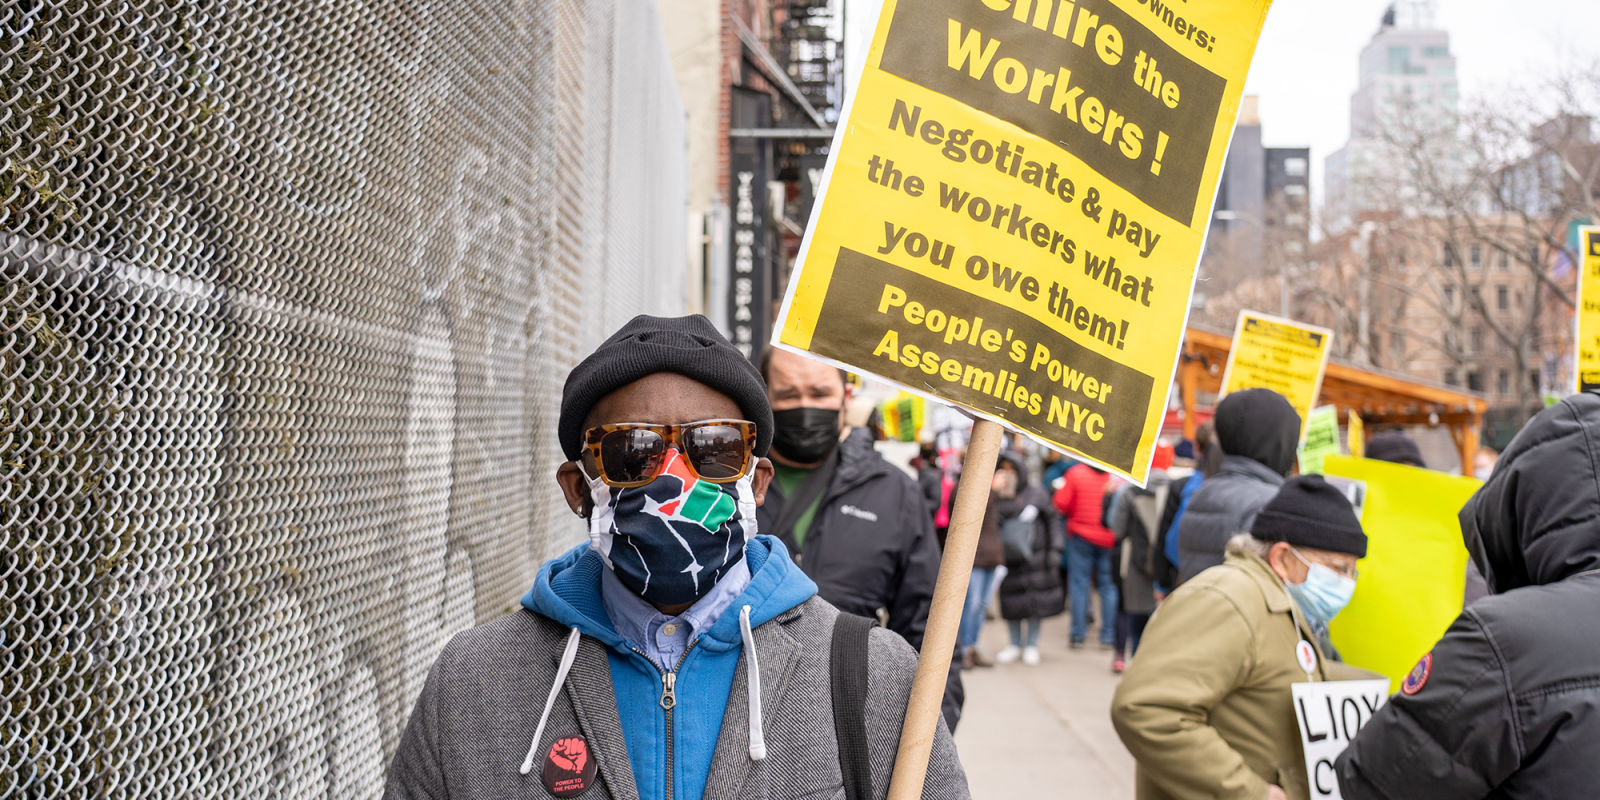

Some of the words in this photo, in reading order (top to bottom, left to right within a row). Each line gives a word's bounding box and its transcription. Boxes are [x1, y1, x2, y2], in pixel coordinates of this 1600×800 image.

[1133, 50, 1180, 108] the
[1137, 0, 1216, 53] wners:
[948, 18, 1144, 159] Workers
[867, 154, 925, 197] the
[938, 181, 1076, 263] workers
[1084, 250, 1154, 307] what
[887, 98, 1075, 203] Negotiate
[1082, 187, 1102, 222] &
[1107, 209, 1161, 259] pay
[877, 220, 956, 271] you
[965, 255, 1040, 302] owe
[1047, 281, 1130, 350] them!
[877, 284, 1028, 363] People's
[1030, 343, 1113, 404] Power
[872, 330, 1042, 416] Assemlies
[1046, 395, 1106, 441] NYC
[564, 783, 584, 791] PEOPLE
